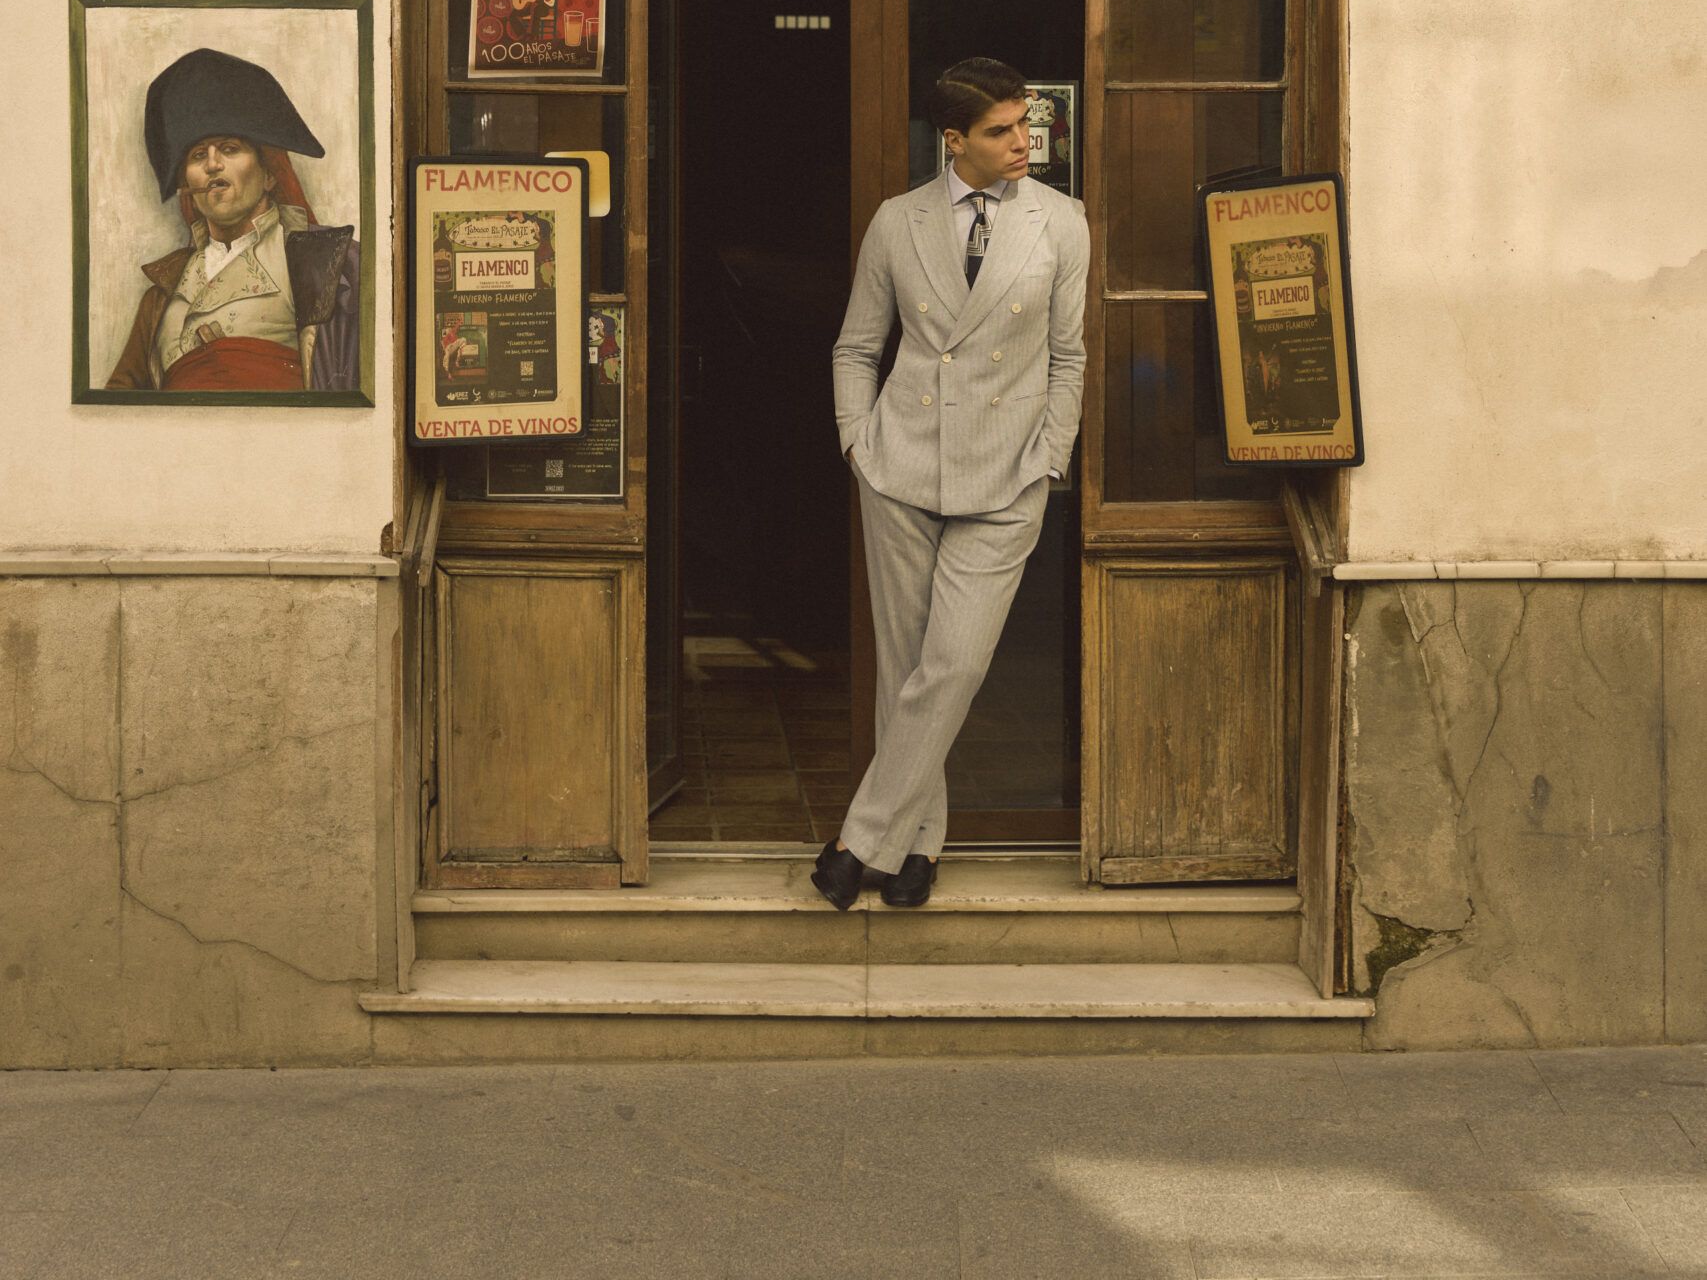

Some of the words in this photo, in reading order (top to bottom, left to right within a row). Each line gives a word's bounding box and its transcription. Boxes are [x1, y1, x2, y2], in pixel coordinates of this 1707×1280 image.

[523, 55, 535, 64] EL
[539, 50, 577, 65] PASAJE
[526, 42, 552, 55] AÑOS
[424, 167, 573, 193] FLAMENCO
[1214, 188, 1331, 223] FLAMENCO
[461, 260, 529, 277] FLAMENCO
[1256, 284, 1310, 307] FLAMENCO
[418, 421, 483, 438] VENTA
[488, 419, 513, 436] DE
[517, 417, 578, 435] VINOS
[1230, 446, 1280, 461] VENTA
[1283, 446, 1303, 461] DE
[1305, 444, 1355, 460] VINOS
